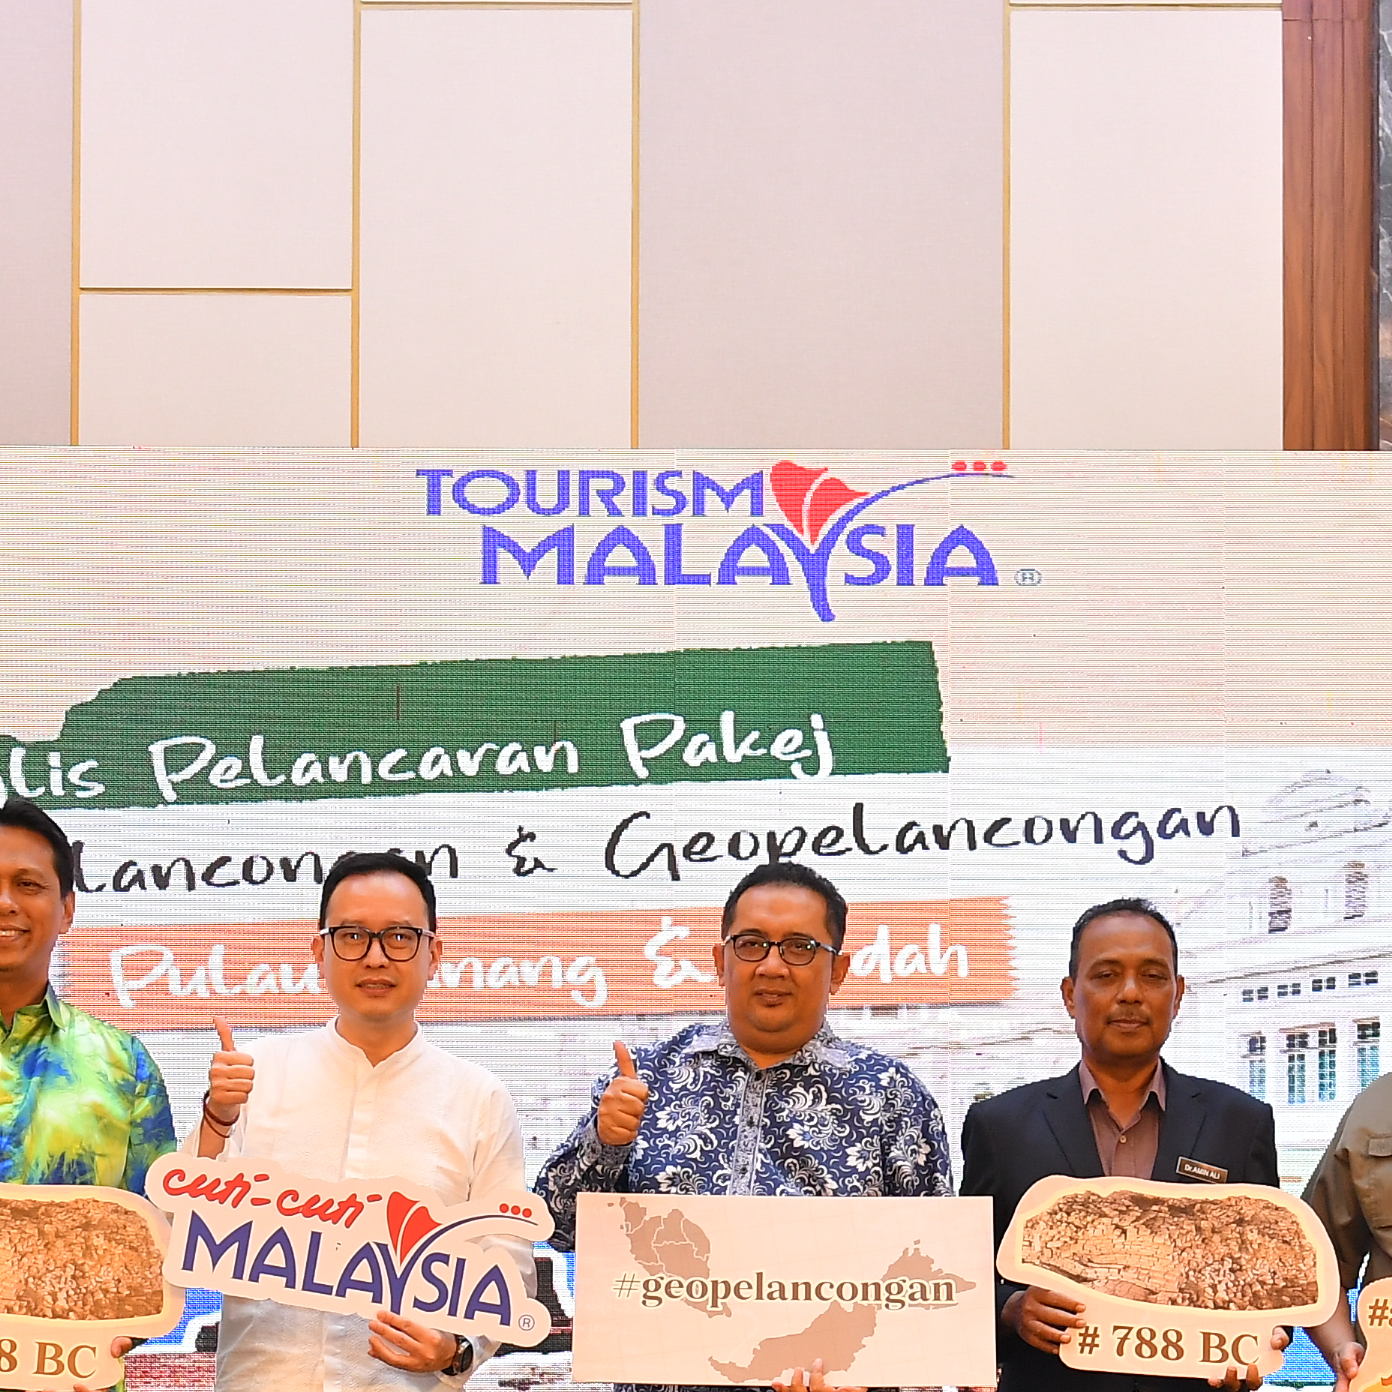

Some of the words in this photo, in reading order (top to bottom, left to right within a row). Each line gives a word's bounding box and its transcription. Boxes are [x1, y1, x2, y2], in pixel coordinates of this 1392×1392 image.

[415, 469, 764, 517] TOURISM
[479, 523, 1000, 622] MALAYSIA
[148, 735, 579, 801] Pelancaran
[619, 711, 835, 780] Pakej
[505, 825, 557, 877] &
[605, 802, 1241, 881] Geopelancongan
[111, 944, 321, 1009] Pulau
[643, 917, 712, 988] &
[849, 922, 969, 984] dah
[162, 1168, 383, 1229] cuti-cuti
[181, 1209, 512, 1326] MALAYSIA
[613, 1272, 955, 1310] #geopelancongan
[32, 1341, 97, 1379] BC
[1078, 1325, 1100, 1355] #
[1111, 1325, 1185, 1361] 788
[1198, 1331, 1259, 1366] BC
